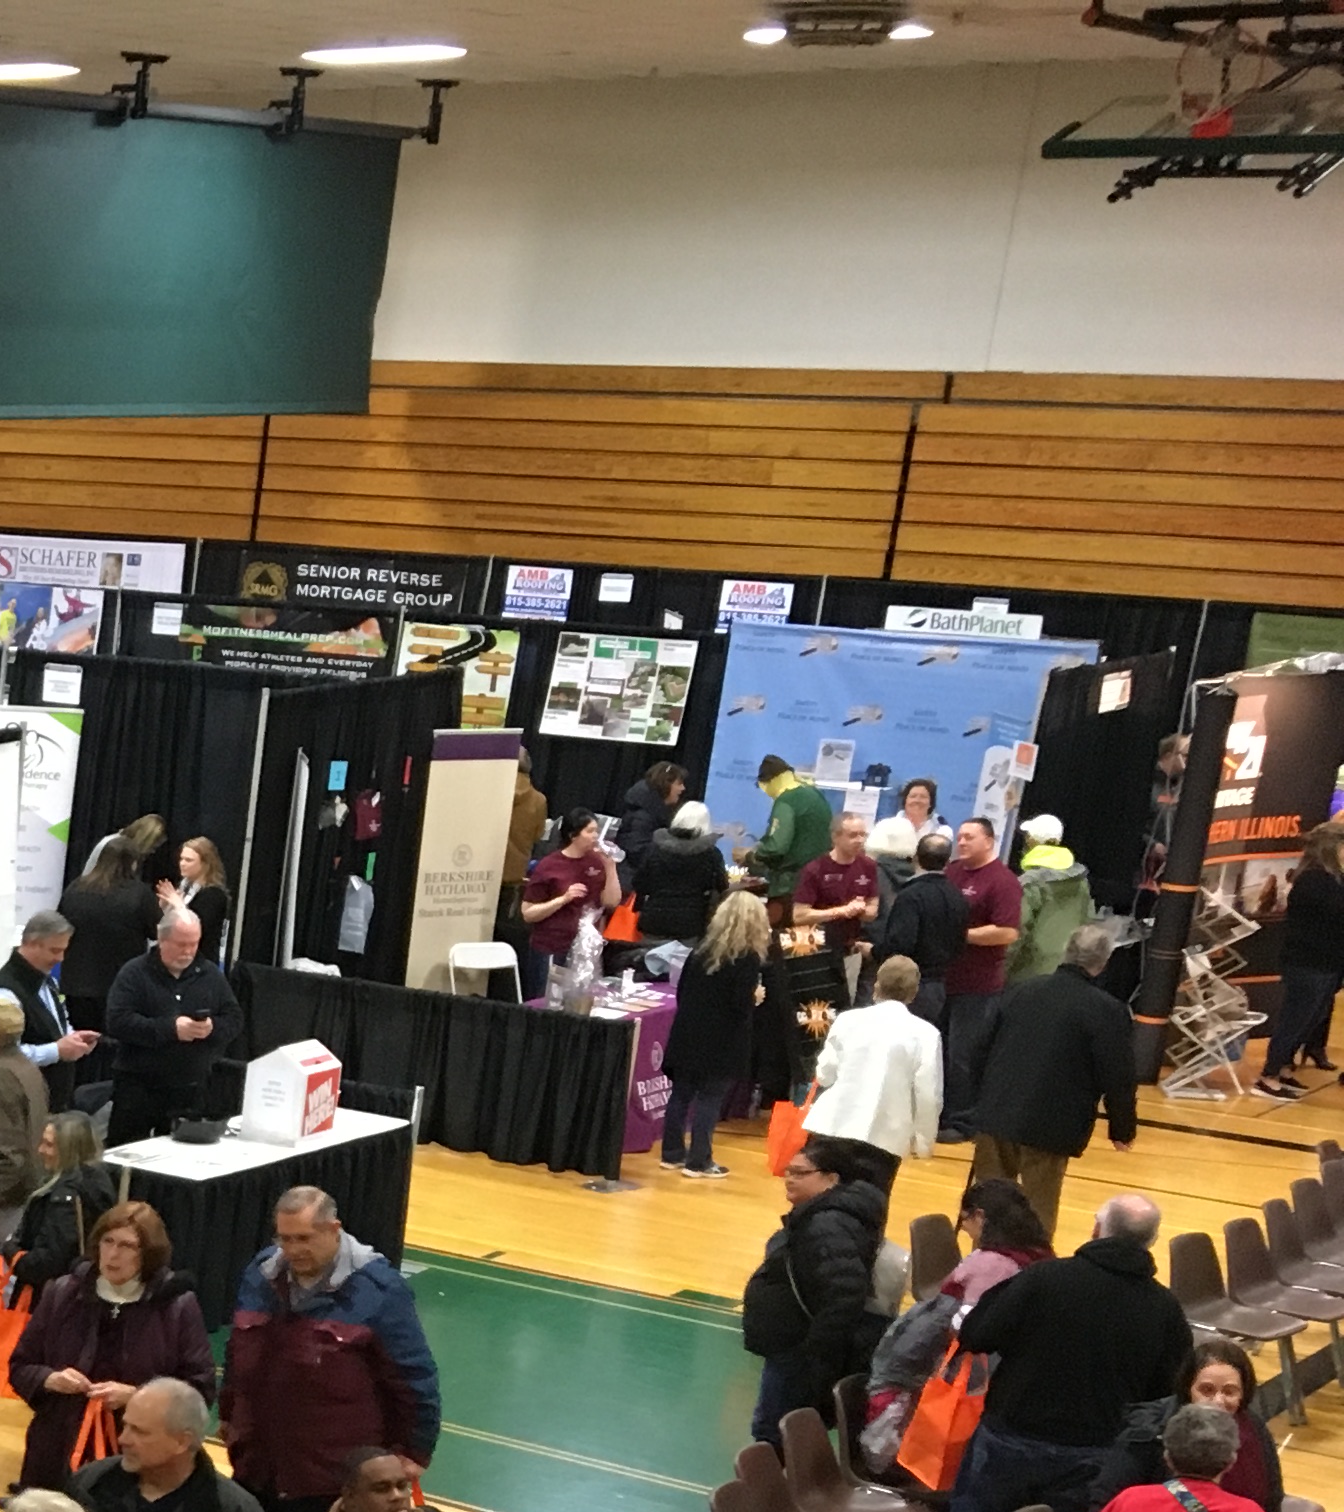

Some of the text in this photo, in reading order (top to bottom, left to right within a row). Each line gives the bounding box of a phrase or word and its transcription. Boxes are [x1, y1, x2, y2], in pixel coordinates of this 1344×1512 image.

[19, 547, 98, 568] SCHAFER
[296, 563, 443, 587] SENIOR REVERSE
[517, 568, 549, 580] AMB
[515, 579, 564, 591] ROOFING
[731, 583, 767, 595] AMB
[296, 583, 453, 607] MORTGAGE GROUP
[730, 592, 784, 606] ROOFING
[929, 611, 1023, 636] BathPlanet
[305, 656, 325, 665] AND
[327, 658, 374, 669] EVERYDAY
[423, 870, 495, 884] BERKSHIRE
[424, 883, 489, 896] HATHAWAY
[308, 1076, 333, 1113] WIN
